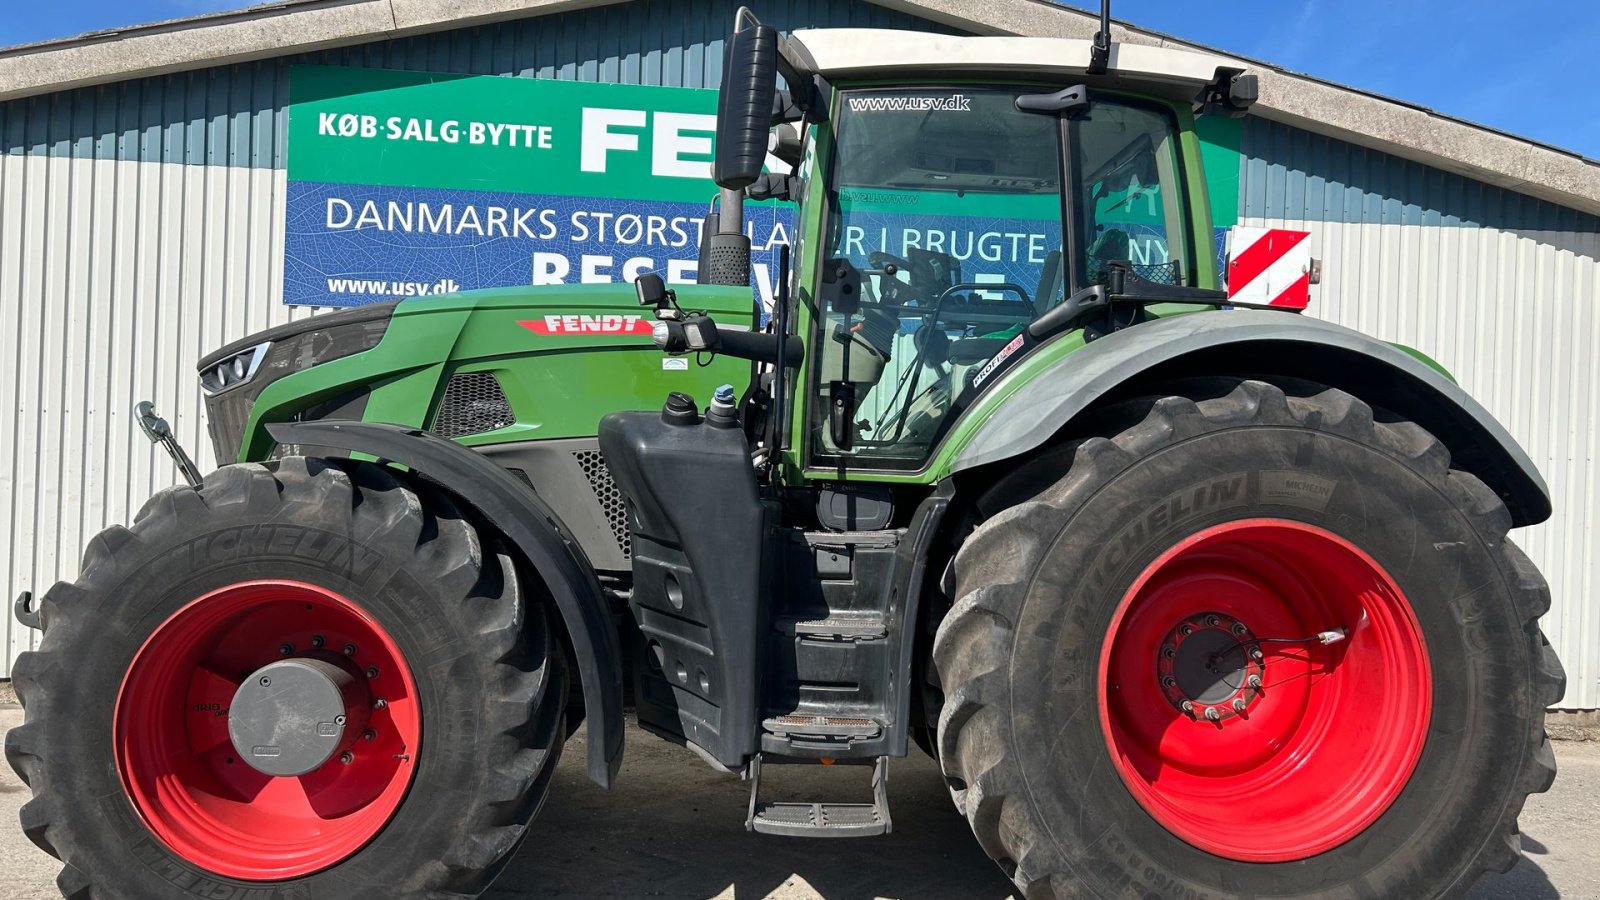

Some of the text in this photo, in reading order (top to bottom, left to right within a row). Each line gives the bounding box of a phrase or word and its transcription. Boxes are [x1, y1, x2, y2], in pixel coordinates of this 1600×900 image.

[849, 94, 971, 111] www.usv.dk
[326, 197, 557, 241] DANMARKS
[571, 211, 707, 248] STØRST
[902, 228, 1046, 263] BRUGTE
[327, 278, 460, 297] www.usv.dk
[544, 314, 642, 332] FENDT
[1285, 478, 1330, 496] MICHELIN
